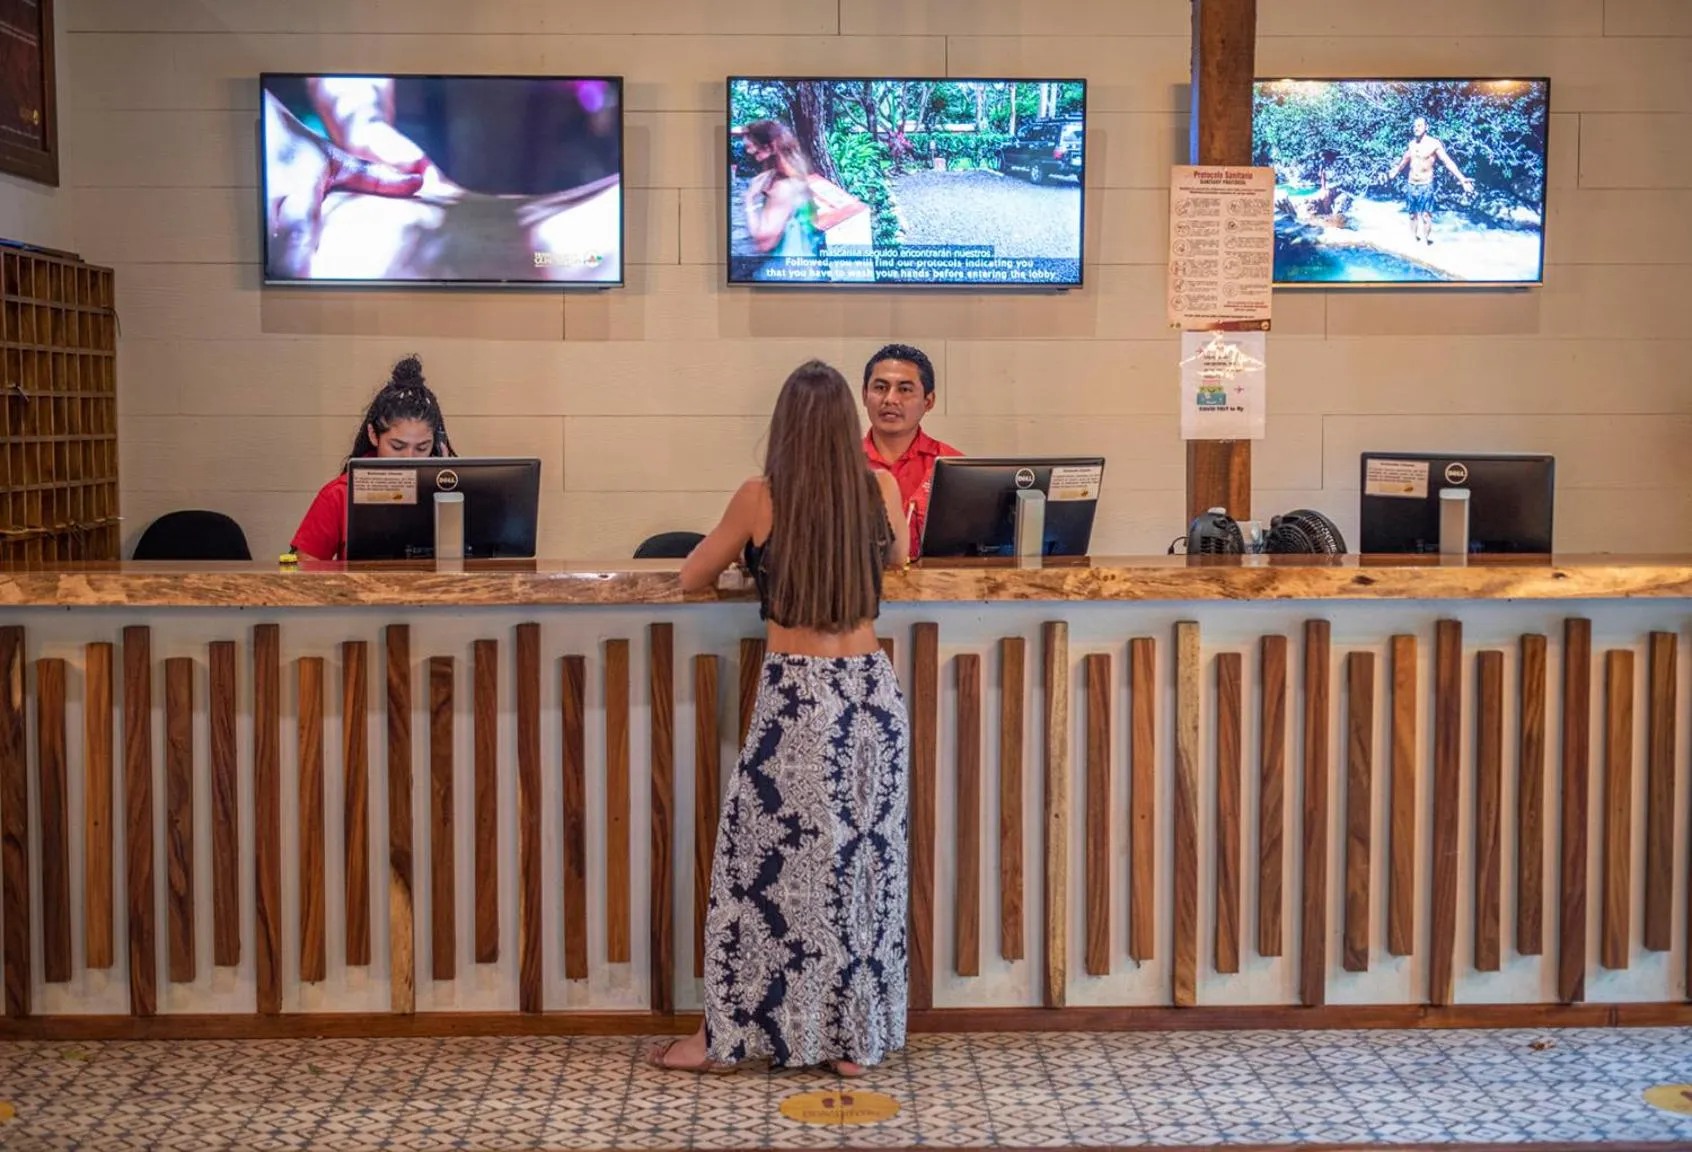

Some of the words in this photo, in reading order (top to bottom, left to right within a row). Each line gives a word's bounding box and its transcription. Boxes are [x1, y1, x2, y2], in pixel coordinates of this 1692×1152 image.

[954, 249, 991, 257] nuestros
[834, 260, 852, 268] you
[855, 257, 874, 266] will
[875, 257, 895, 267] find
[916, 258, 962, 269] protocols
[965, 258, 1013, 269] indicating
[1015, 259, 1034, 269] you
[766, 269, 786, 277] that
[789, 271, 806, 279] you
[807, 269, 831, 277] have
[875, 270, 898, 280] your
[901, 268, 929, 278] hands
[932, 268, 964, 278] before
[967, 269, 1007, 280] entering
[1010, 269, 1026, 279] the
[1447, 470, 1464, 478] DELL
[439, 476, 455, 484] DELL
